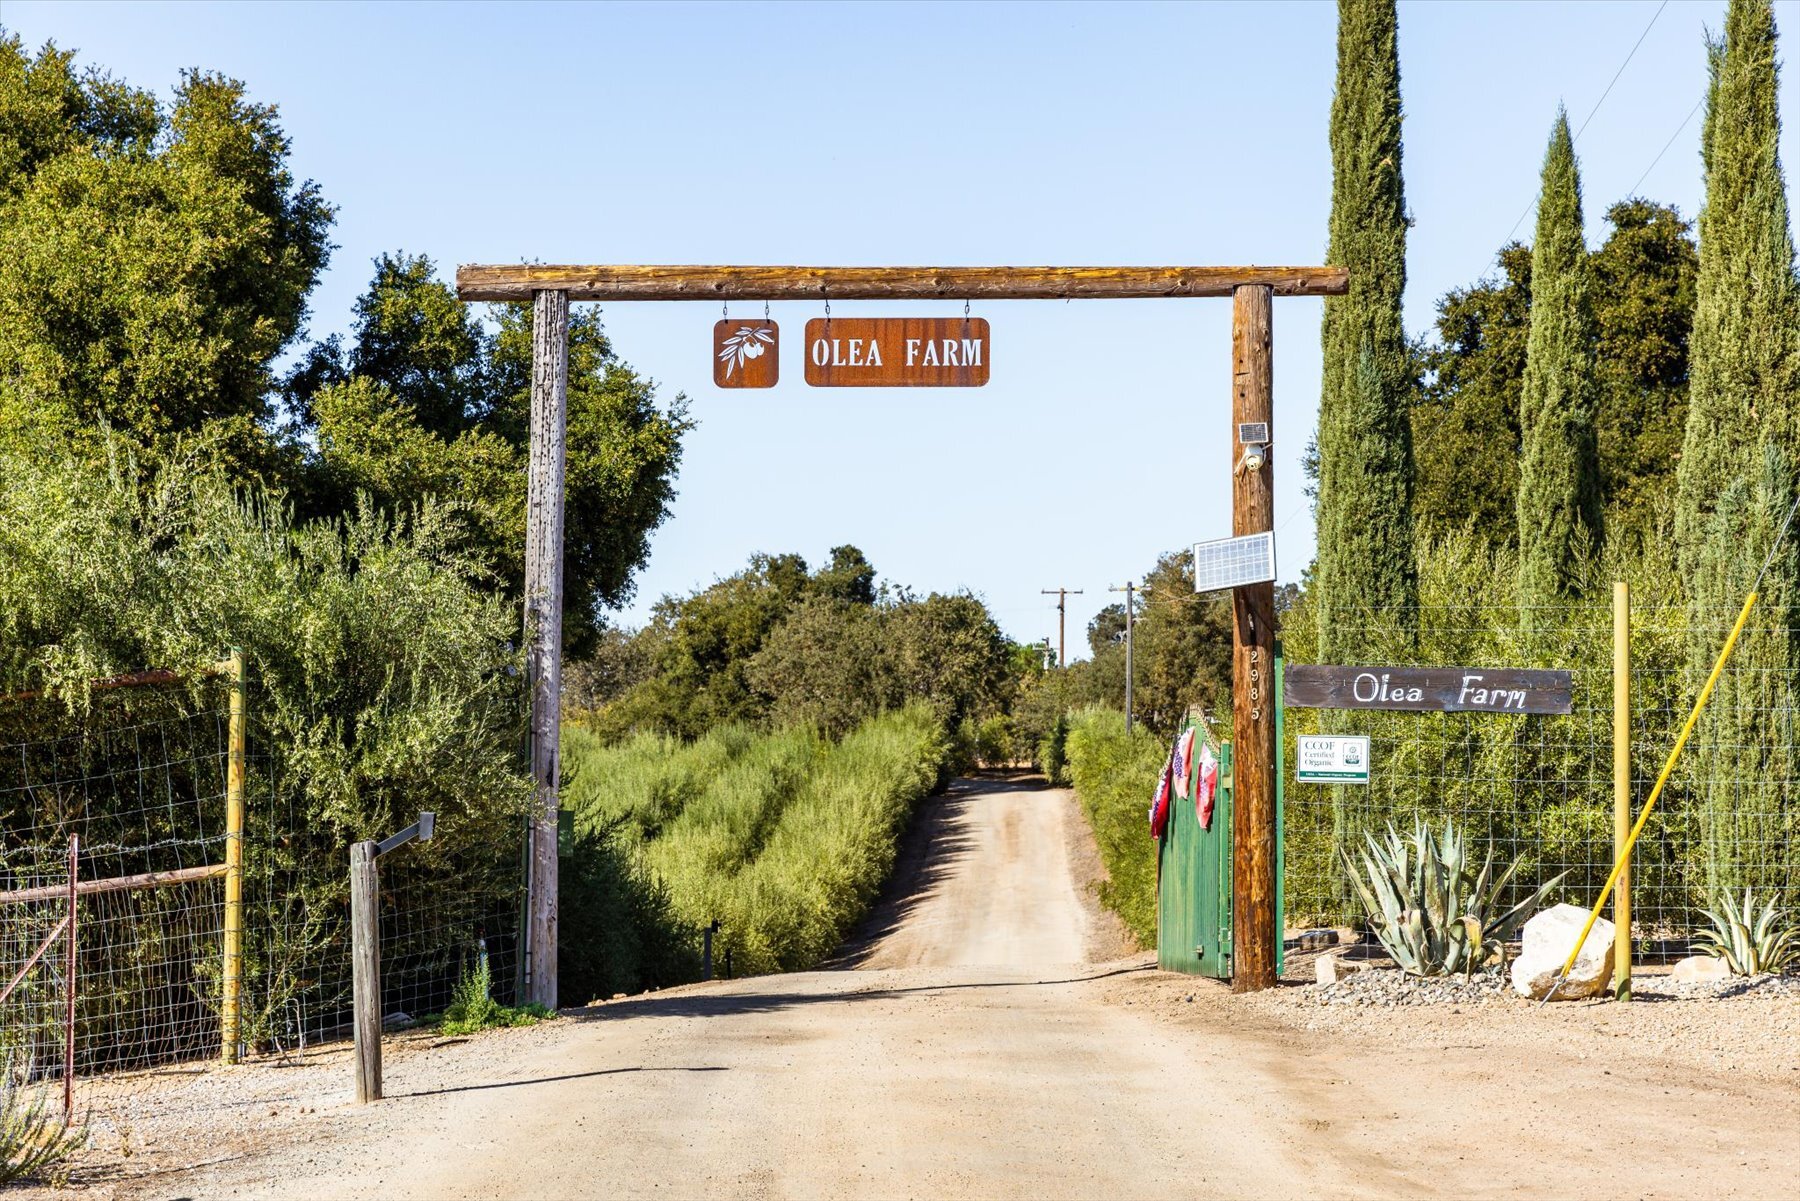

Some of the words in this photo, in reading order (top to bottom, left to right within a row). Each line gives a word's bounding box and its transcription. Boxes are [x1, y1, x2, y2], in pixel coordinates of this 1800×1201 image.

[812, 339, 882, 366] OLEA
[905, 339, 982, 366] FARM
[1250, 650, 1259, 720] 2985
[1353, 673, 1424, 702] Olea
[1457, 675, 1527, 709] Farm
[1305, 741, 1335, 750] CCOF
[1304, 751, 1334, 759] Certified
[1304, 759, 1332, 767] Organic
